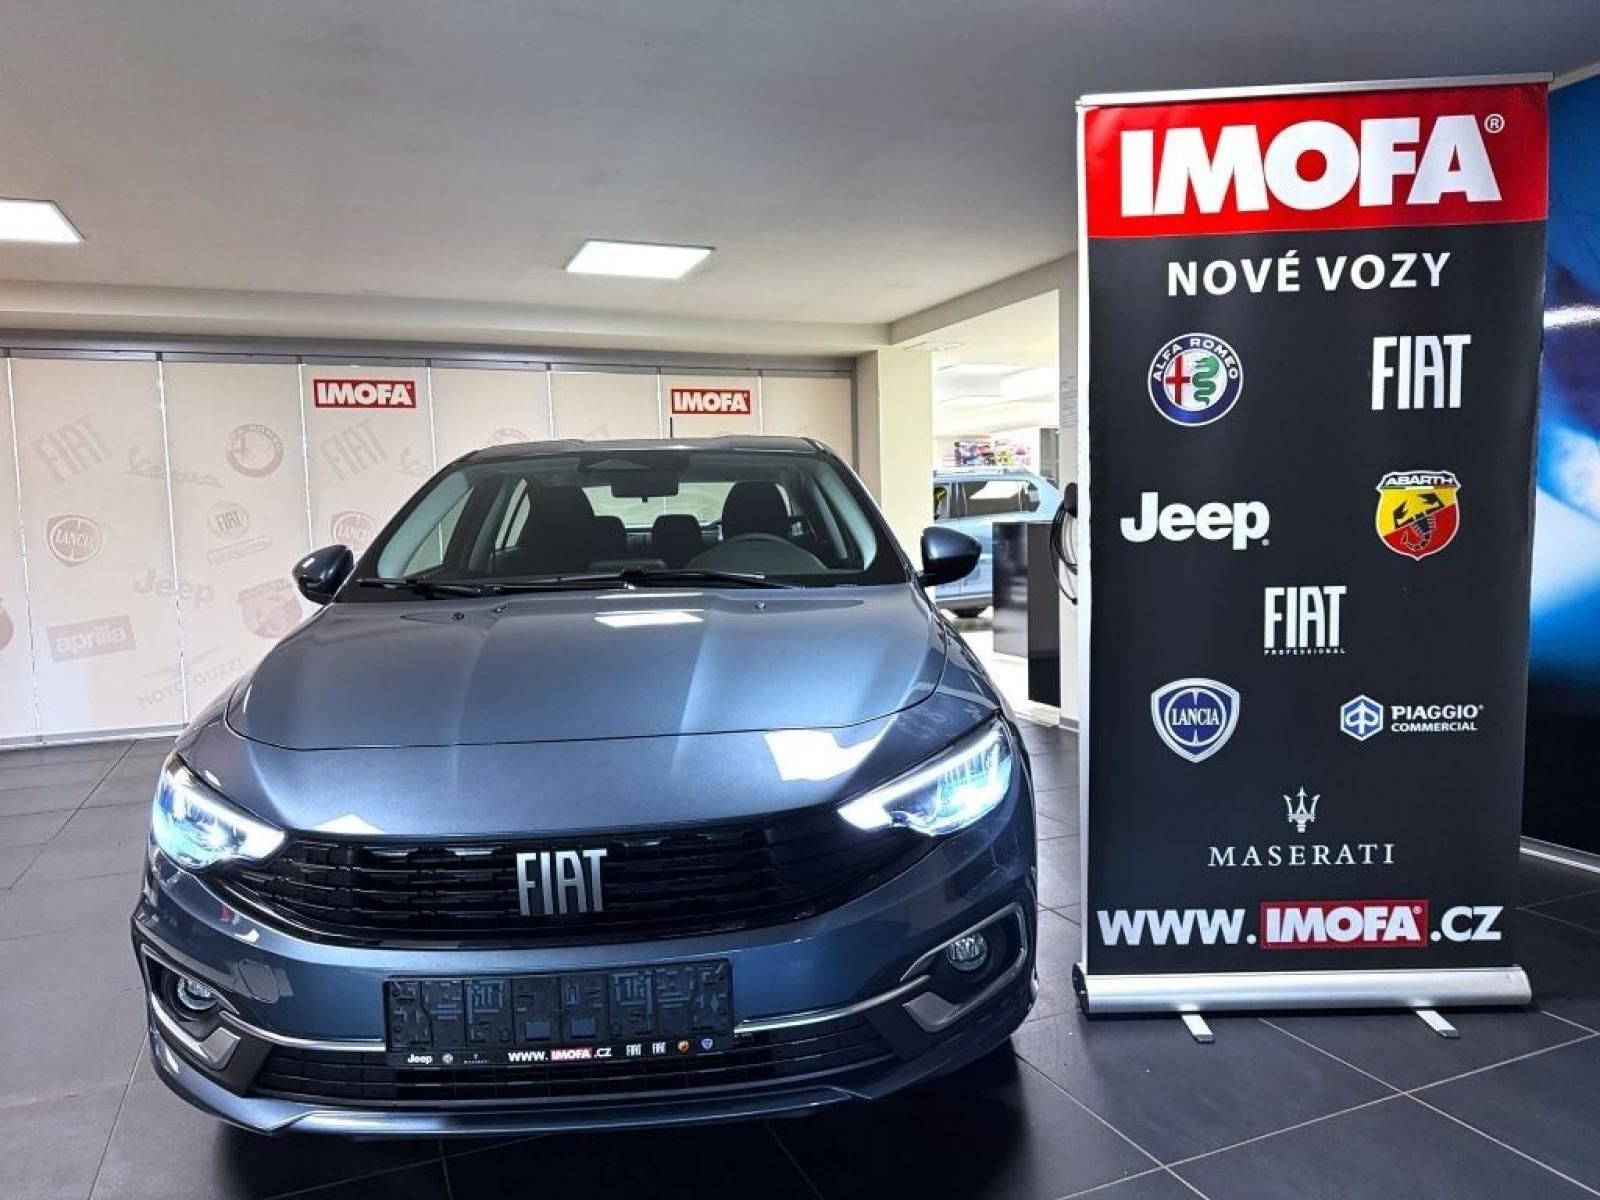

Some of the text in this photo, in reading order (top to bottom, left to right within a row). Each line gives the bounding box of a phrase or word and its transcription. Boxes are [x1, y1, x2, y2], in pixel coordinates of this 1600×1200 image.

[1120, 114, 1502, 217] IMOFA
[1168, 250, 1451, 296] NOVÉ VOZY
[1153, 338, 1239, 382] ALFA ROMEO
[1371, 334, 1472, 411] FIAT
[316, 382, 413, 406] IMOFA
[673, 391, 748, 412] IMOFA
[31, 413, 113, 484] FIAT
[319, 417, 389, 482] FIAT
[1385, 474, 1453, 486] ABARTH
[1120, 491, 1270, 551] Jeep
[133, 569, 215, 608] Jeep
[1264, 585, 1347, 648] FIAT
[54, 621, 127, 656] aprilia
[1172, 707, 1221, 726] LANCIA
[1391, 704, 1479, 720] PIAGGIO
[1391, 721, 1478, 732] COMMERCIAL
[1208, 842, 1396, 867] MASERATI
[516, 848, 608, 917] FIAT
[407, 1053, 433, 1064] Jeep
